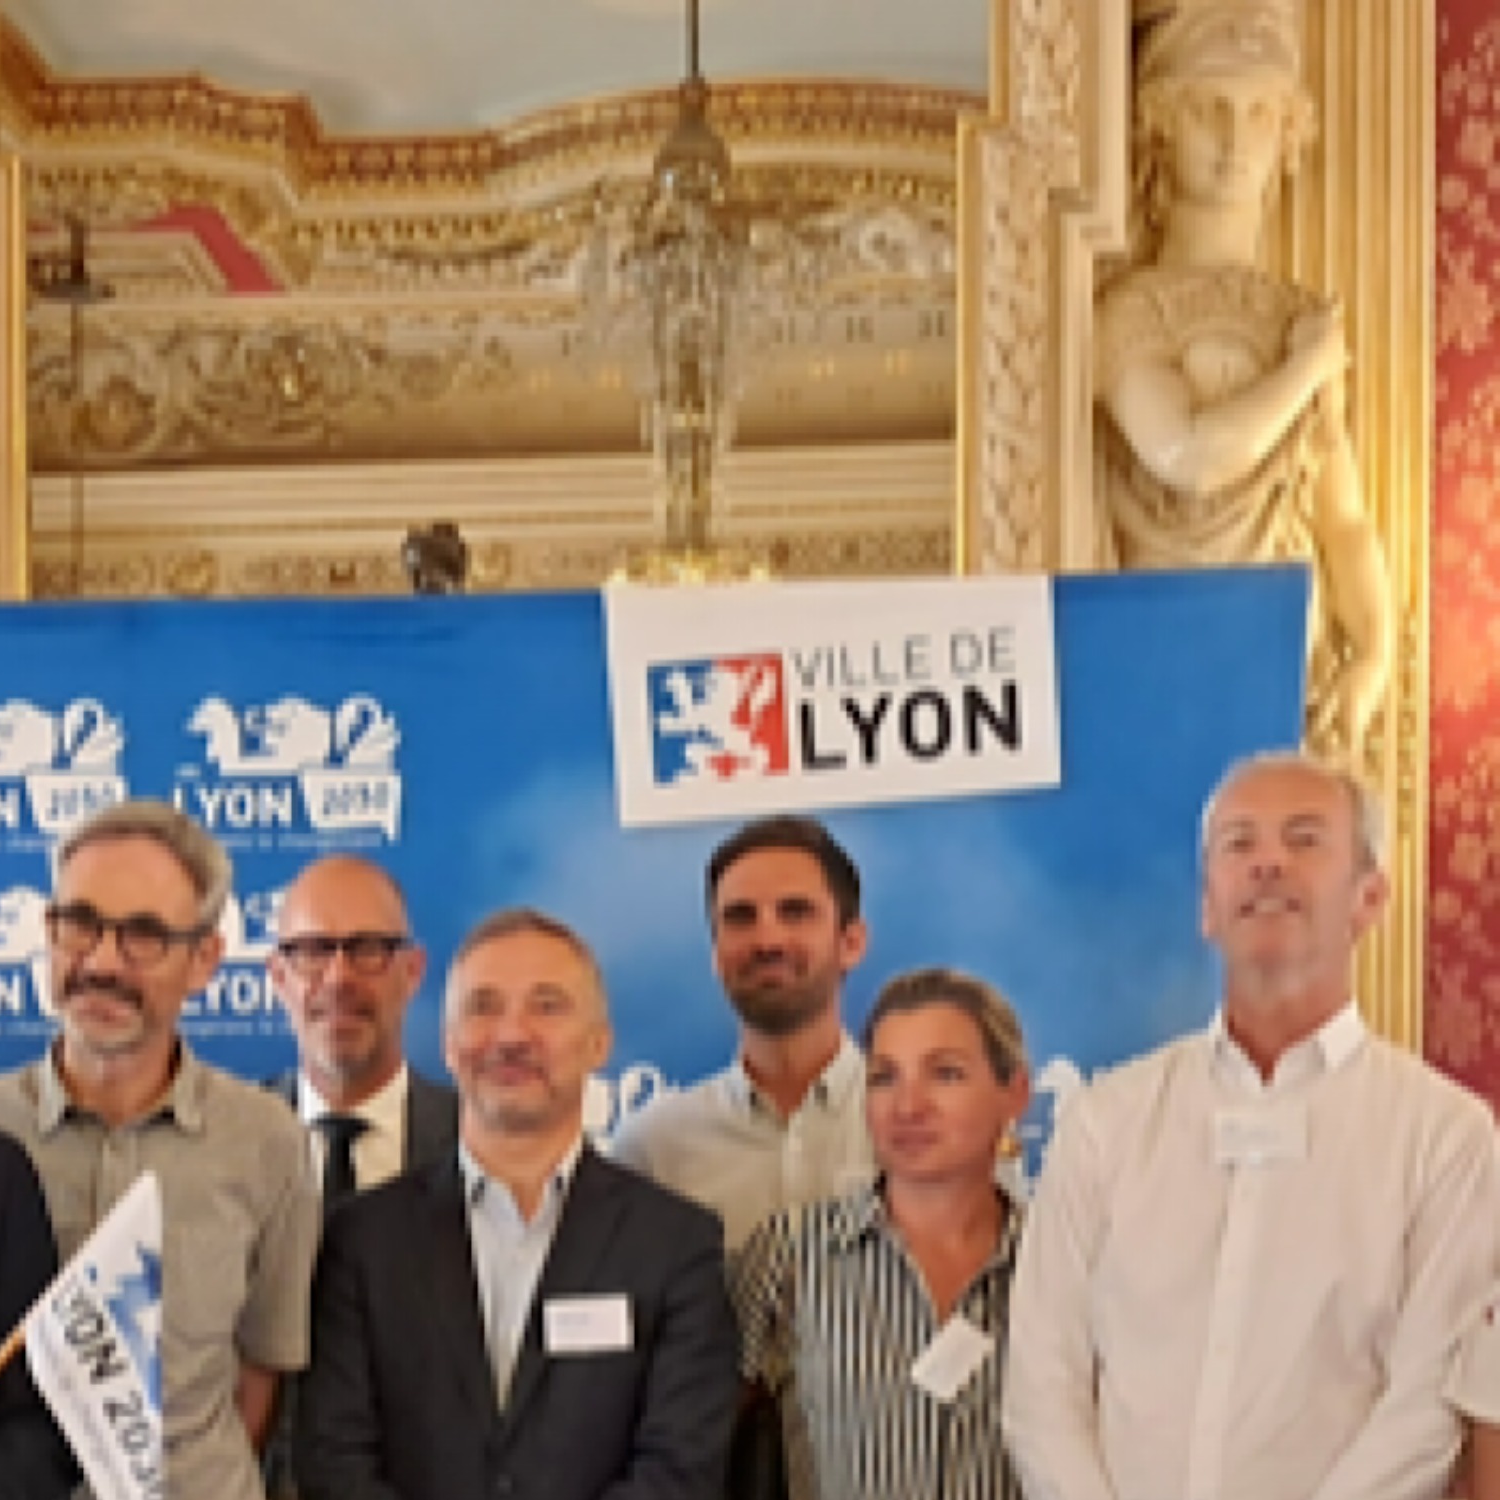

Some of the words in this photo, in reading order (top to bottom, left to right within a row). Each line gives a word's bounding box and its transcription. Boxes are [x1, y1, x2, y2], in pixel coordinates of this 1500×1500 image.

[792, 633, 934, 688] VILLE
[947, 627, 1017, 679] DE
[799, 680, 1023, 772] LYON
